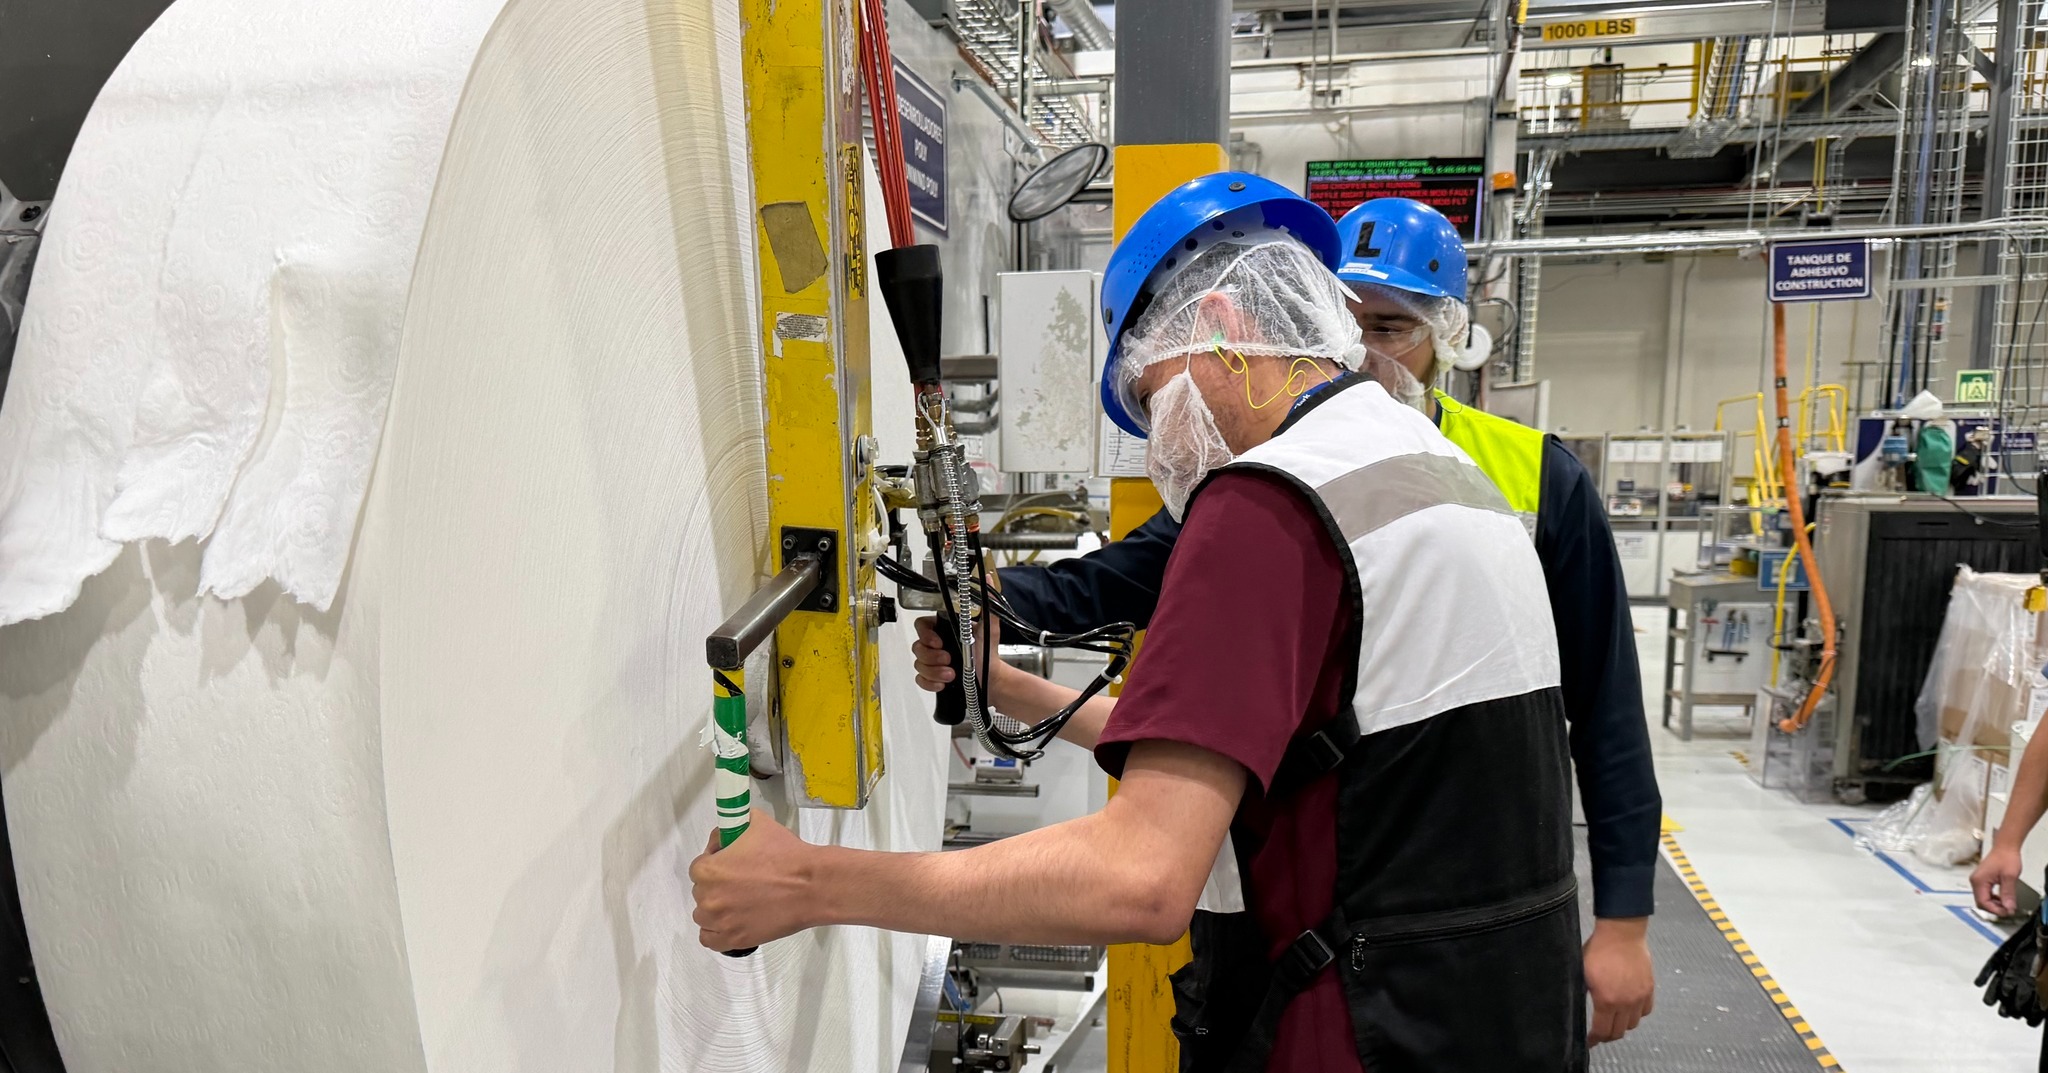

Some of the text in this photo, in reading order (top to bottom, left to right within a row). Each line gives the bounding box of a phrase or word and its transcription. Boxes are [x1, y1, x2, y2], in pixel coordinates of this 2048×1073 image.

[1547, 18, 1632, 40] 1000 LBS
[914, 137, 929, 163] POLY
[1449, 188, 1475, 196] FAULT
[1353, 221, 1381, 258] L
[1786, 252, 1852, 266] TANQUE DE
[1790, 265, 1849, 278] ADHESIVO
[1775, 277, 1864, 292] CONSTRUCTION
